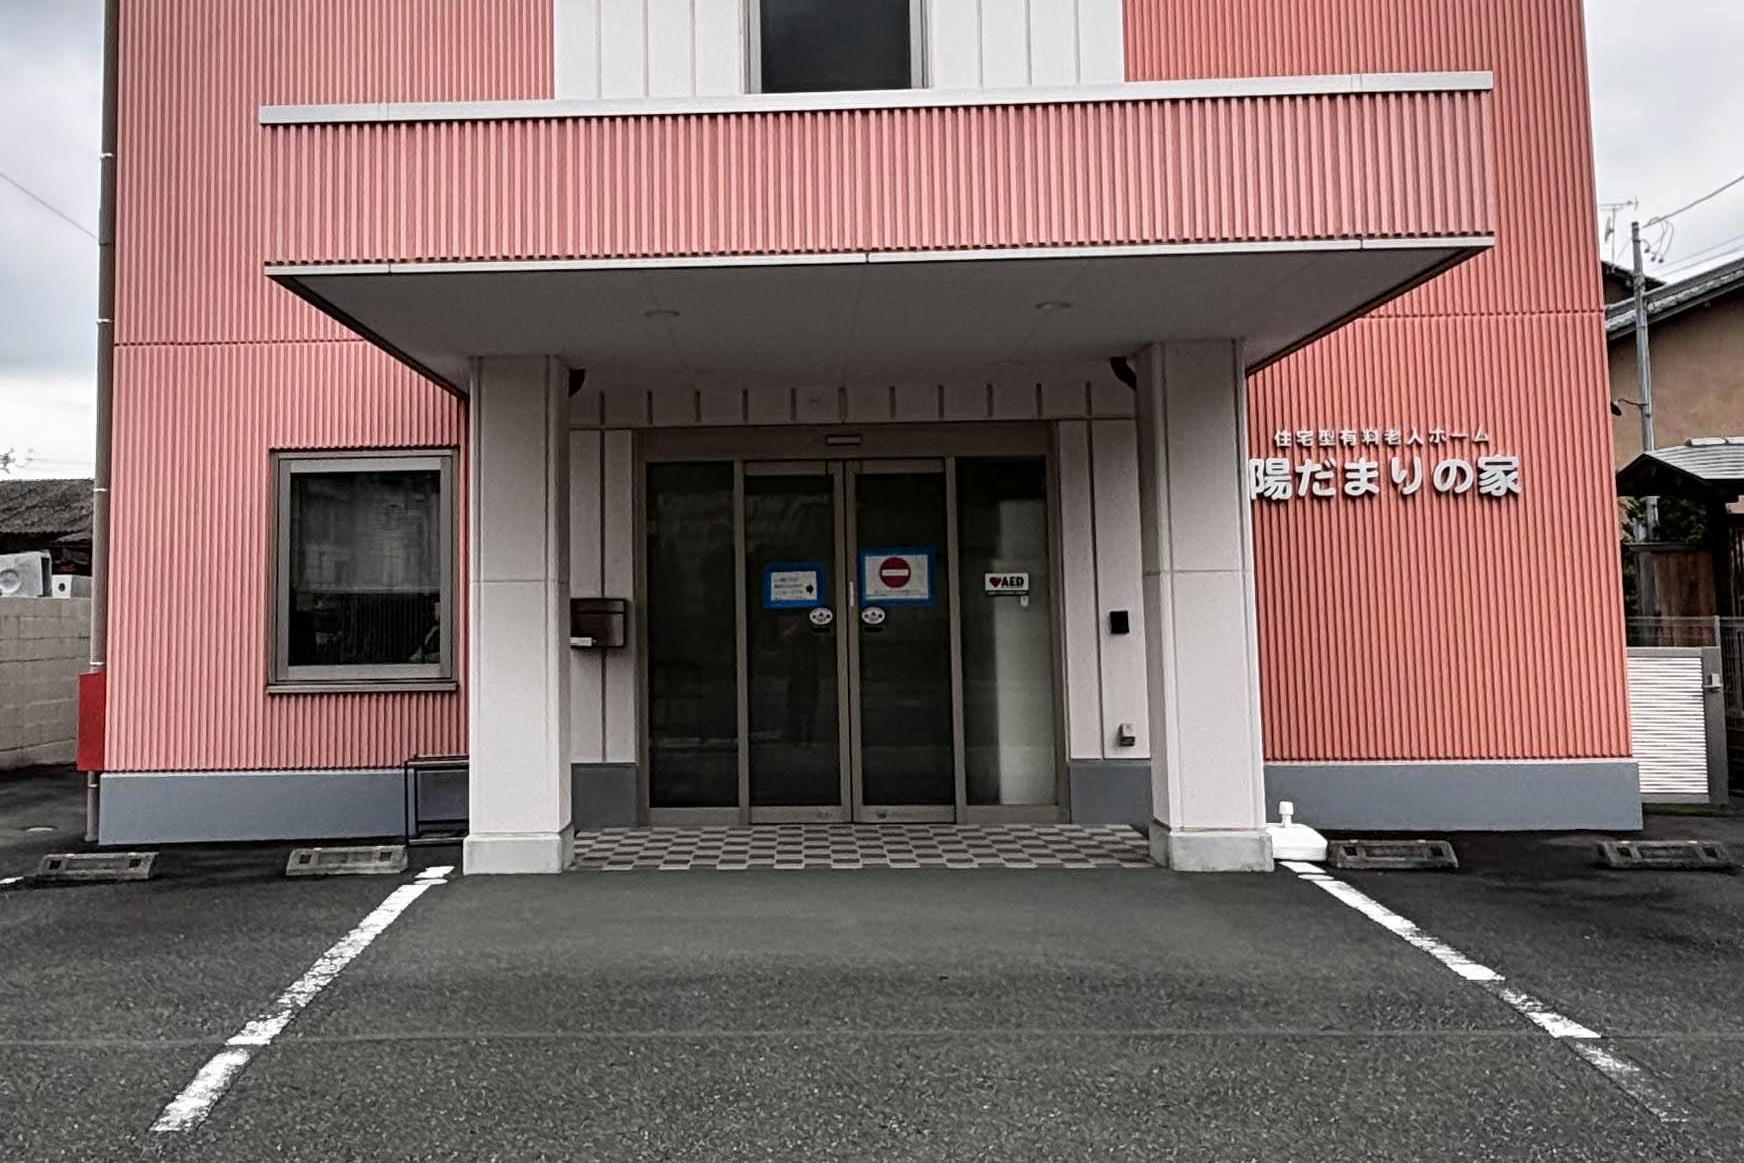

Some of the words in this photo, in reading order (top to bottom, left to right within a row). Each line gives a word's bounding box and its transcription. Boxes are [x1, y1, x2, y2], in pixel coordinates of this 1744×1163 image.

[1274, 425, 1489, 447] 住宅型有料老人ホーム
[1248, 454, 1521, 500] 陽だまりの家
[1001, 576, 1024, 588] AED
